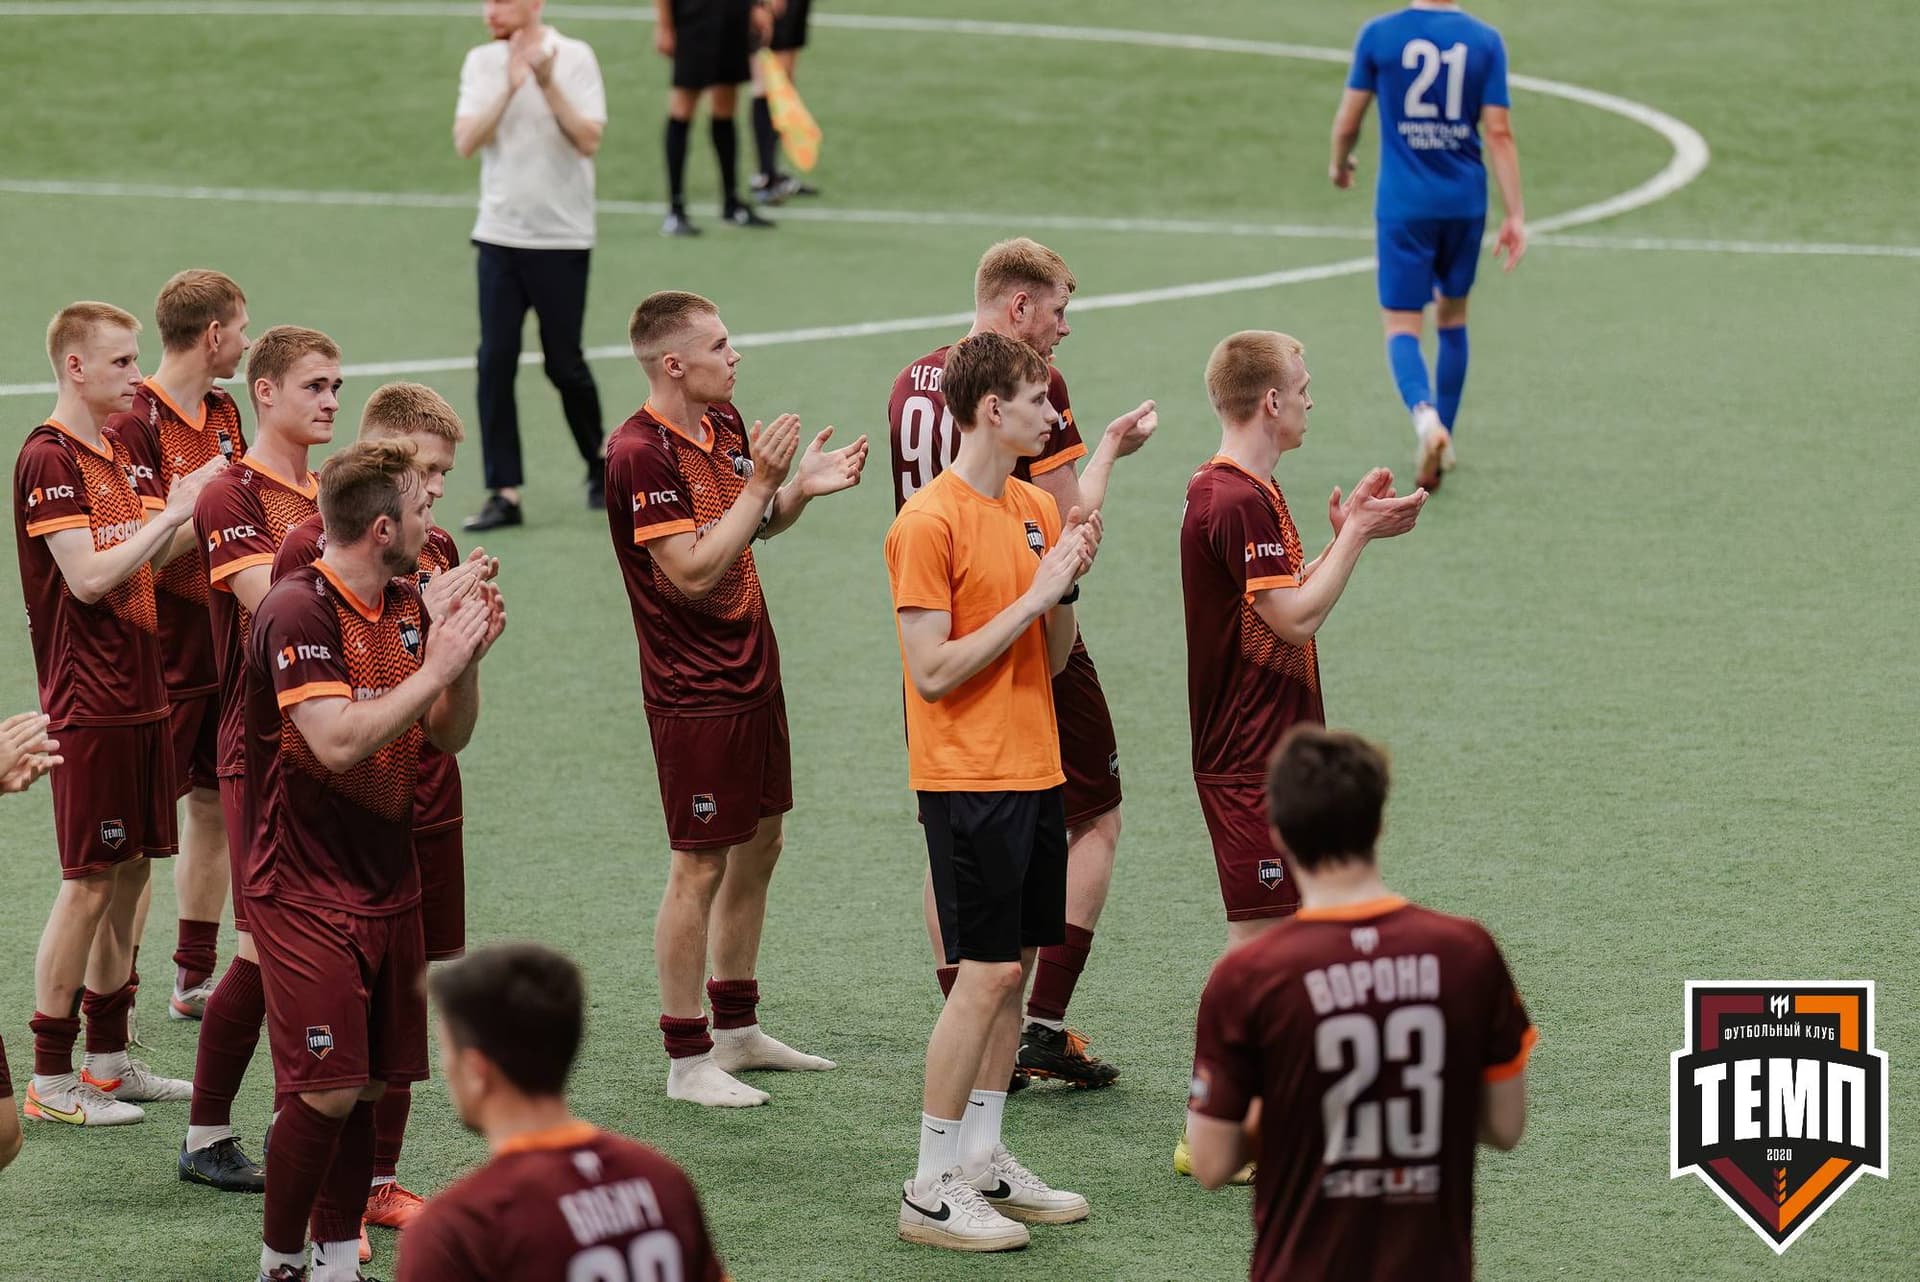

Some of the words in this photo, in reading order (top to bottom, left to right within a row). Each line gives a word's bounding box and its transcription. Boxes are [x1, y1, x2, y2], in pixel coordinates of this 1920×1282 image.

[1401, 38, 1469, 121] 21
[911, 365, 943, 392] ЧЕВ
[649, 490, 679, 505] ПСБ
[223, 525, 257, 542] ПСБ
[1257, 543, 1285, 557] ПСБ
[297, 645, 332, 660] ПСБ
[695, 802, 714, 813] ТЕМП
[103, 828, 123, 840] ТЕМП
[1261, 868, 1281, 879] ТЕМП
[1304, 954, 1440, 1014] ВОРОНА
[309, 1035, 331, 1048] ТЕМП
[1315, 1004, 1446, 1165] 23
